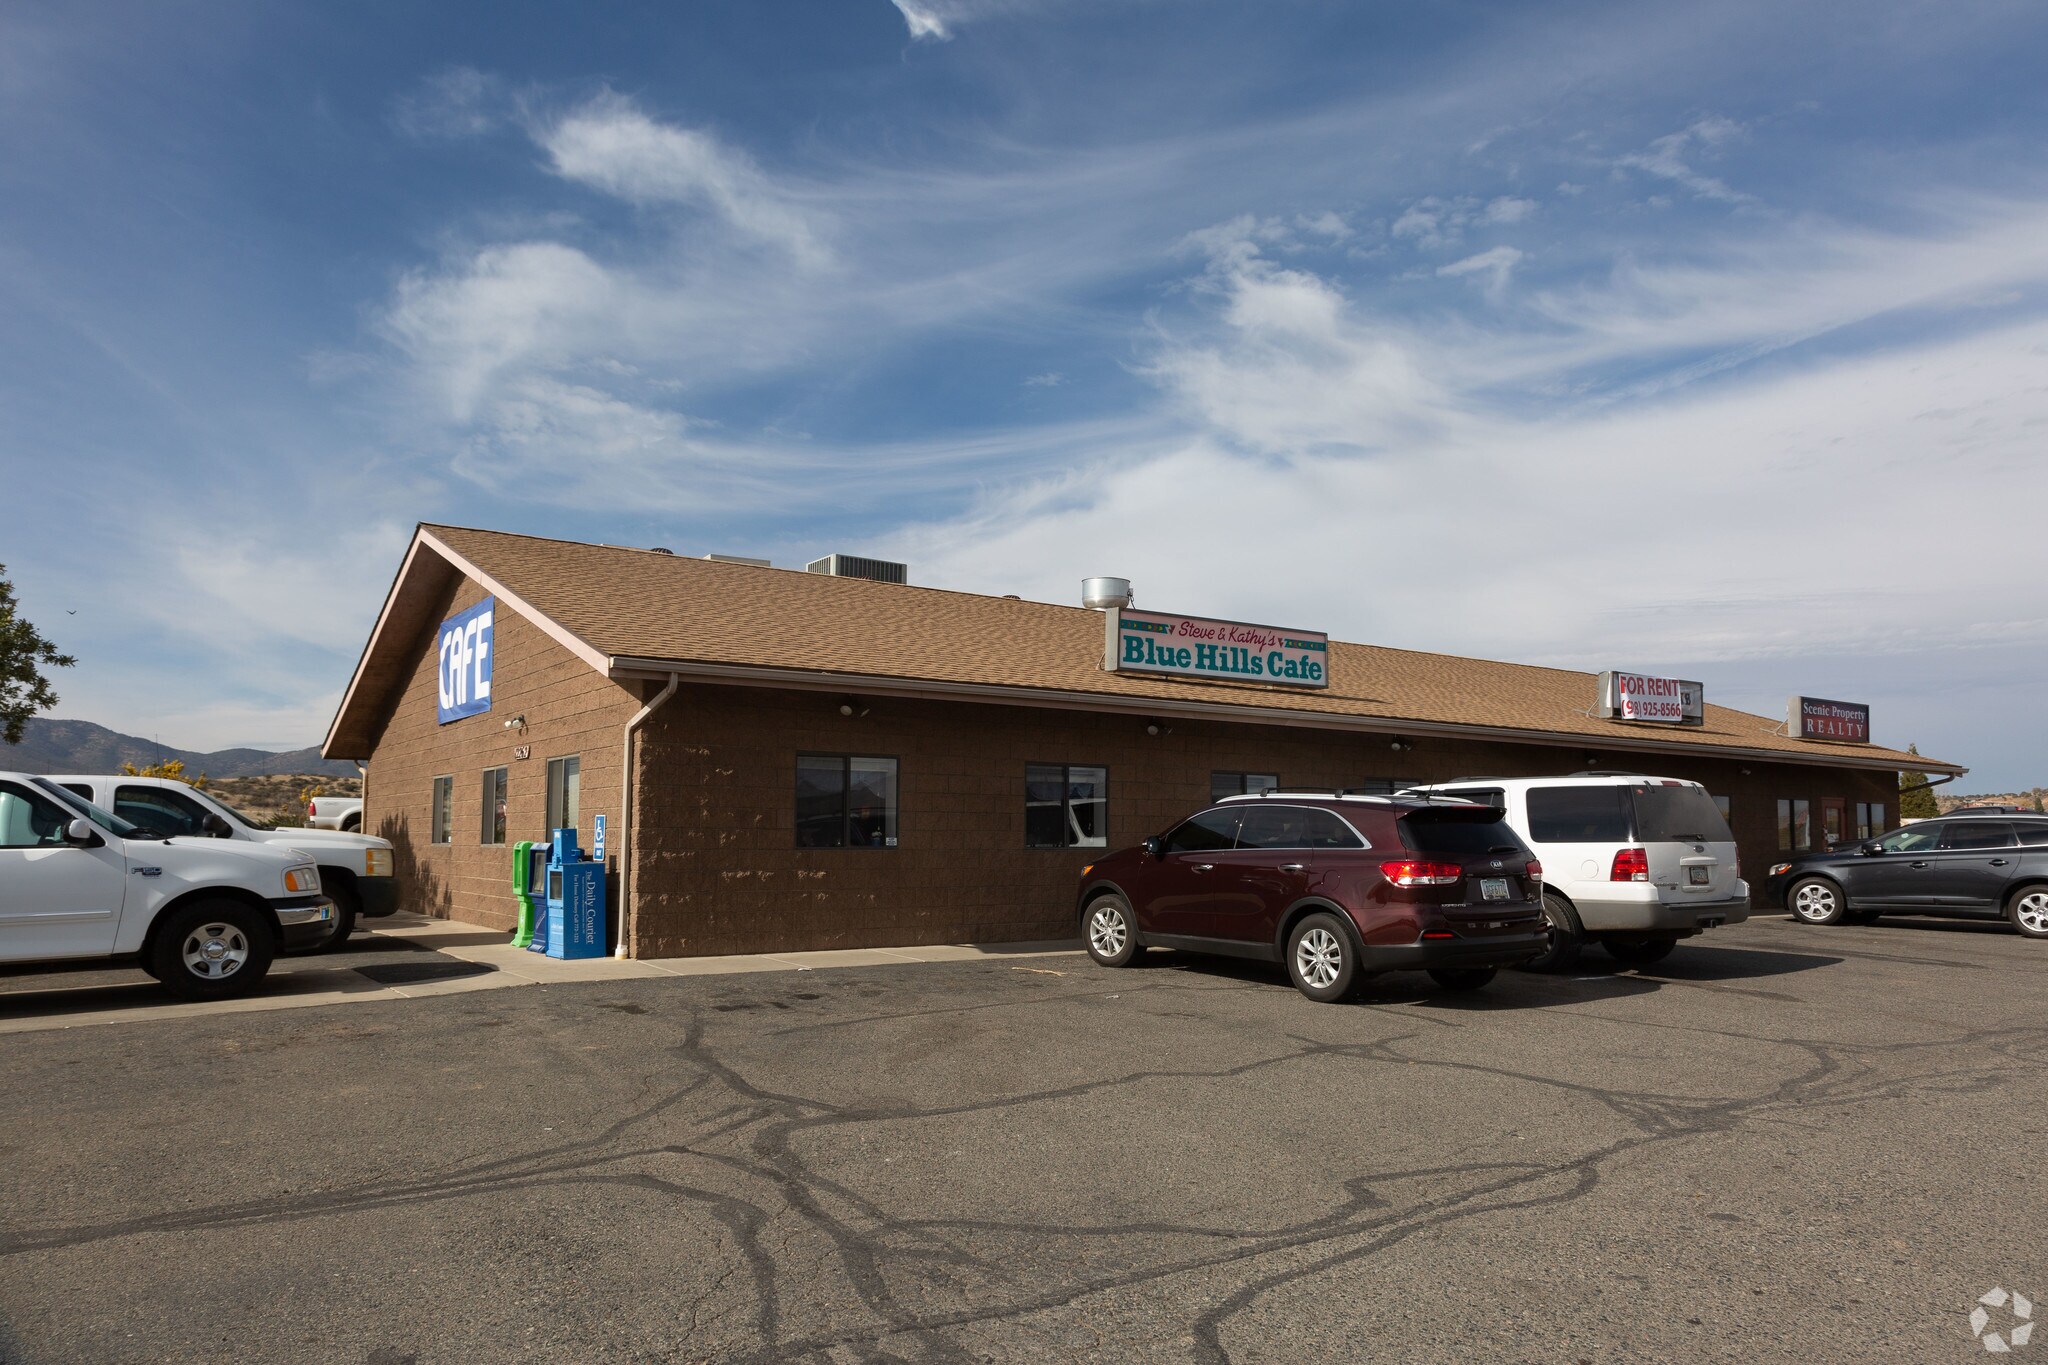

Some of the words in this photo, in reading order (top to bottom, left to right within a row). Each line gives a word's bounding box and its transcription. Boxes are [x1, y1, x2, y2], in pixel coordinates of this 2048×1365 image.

[1179, 621, 1215, 640] Steve
[1218, 627, 1226, 640] &
[1228, 626, 1276, 652] Kathy's
[439, 611, 491, 709] CAFE
[1123, 635, 1192, 669] Blue
[1194, 643, 1263, 675] Hills
[1267, 651, 1322, 680] Cafe
[1620, 675, 1645, 695] FOR
[1647, 677, 1680, 696] RENT
[1643, 701, 1681, 717] 925-8566
[1803, 702, 1830, 716] Scenic
[1832, 705, 1866, 723] Property
[1807, 718, 1864, 737] REALTY
[585, 881, 596, 906] Daily
[586, 909, 596, 944] Courier
